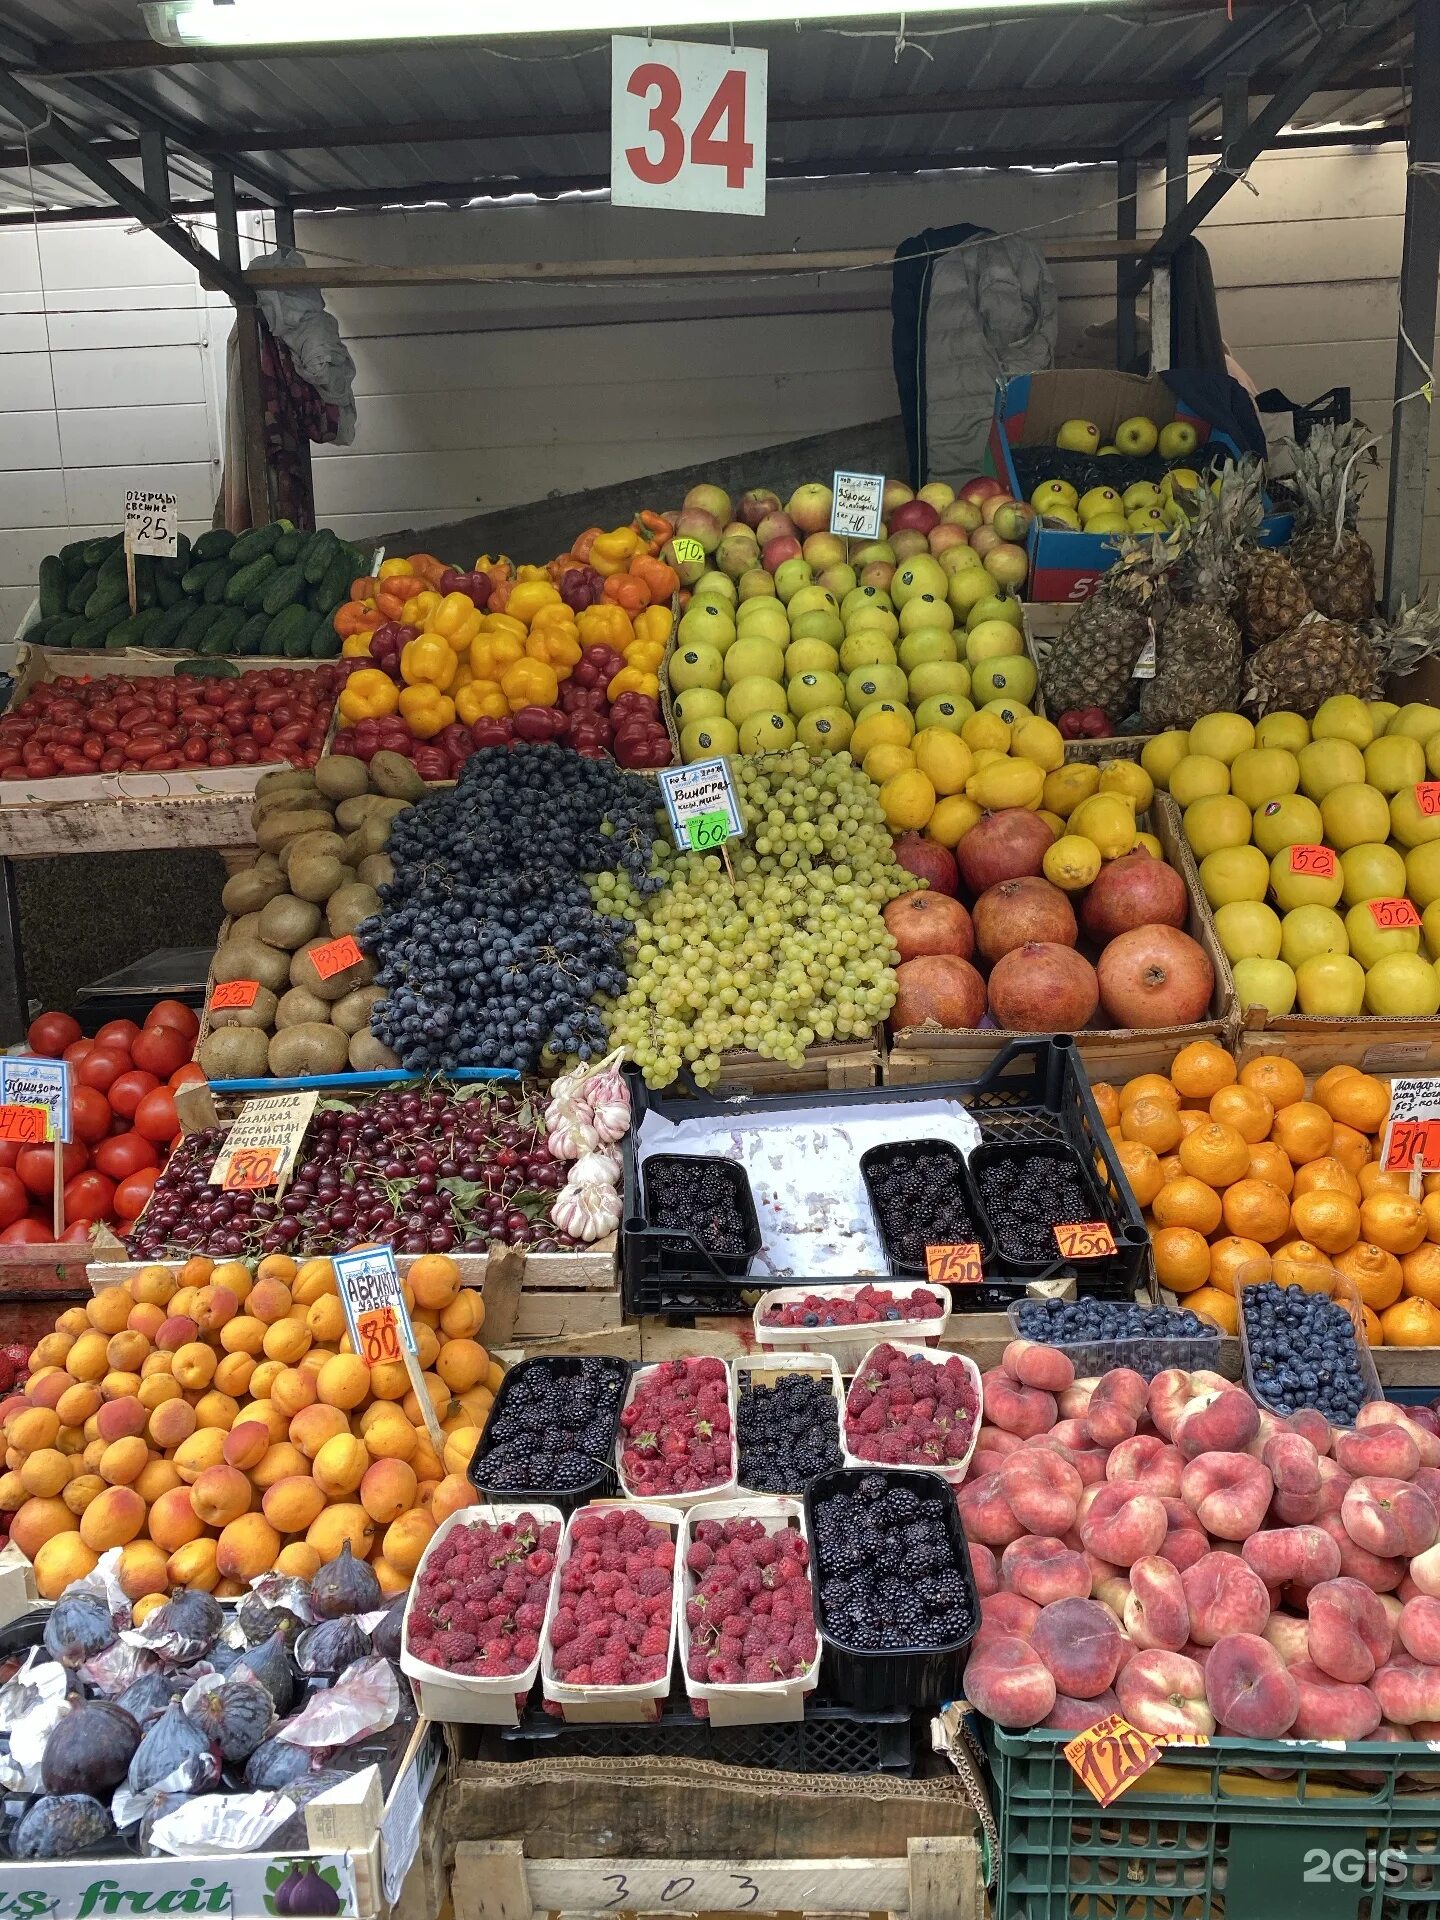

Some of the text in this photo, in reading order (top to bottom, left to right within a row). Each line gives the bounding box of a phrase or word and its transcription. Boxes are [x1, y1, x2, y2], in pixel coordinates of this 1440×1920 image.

[625, 62, 754, 189] 34
[243, 1096, 300, 1113] ВИШНЯ
[1068, 1736, 1094, 1759] ЦЕНА
[78, 1878, 231, 1919] fruit
